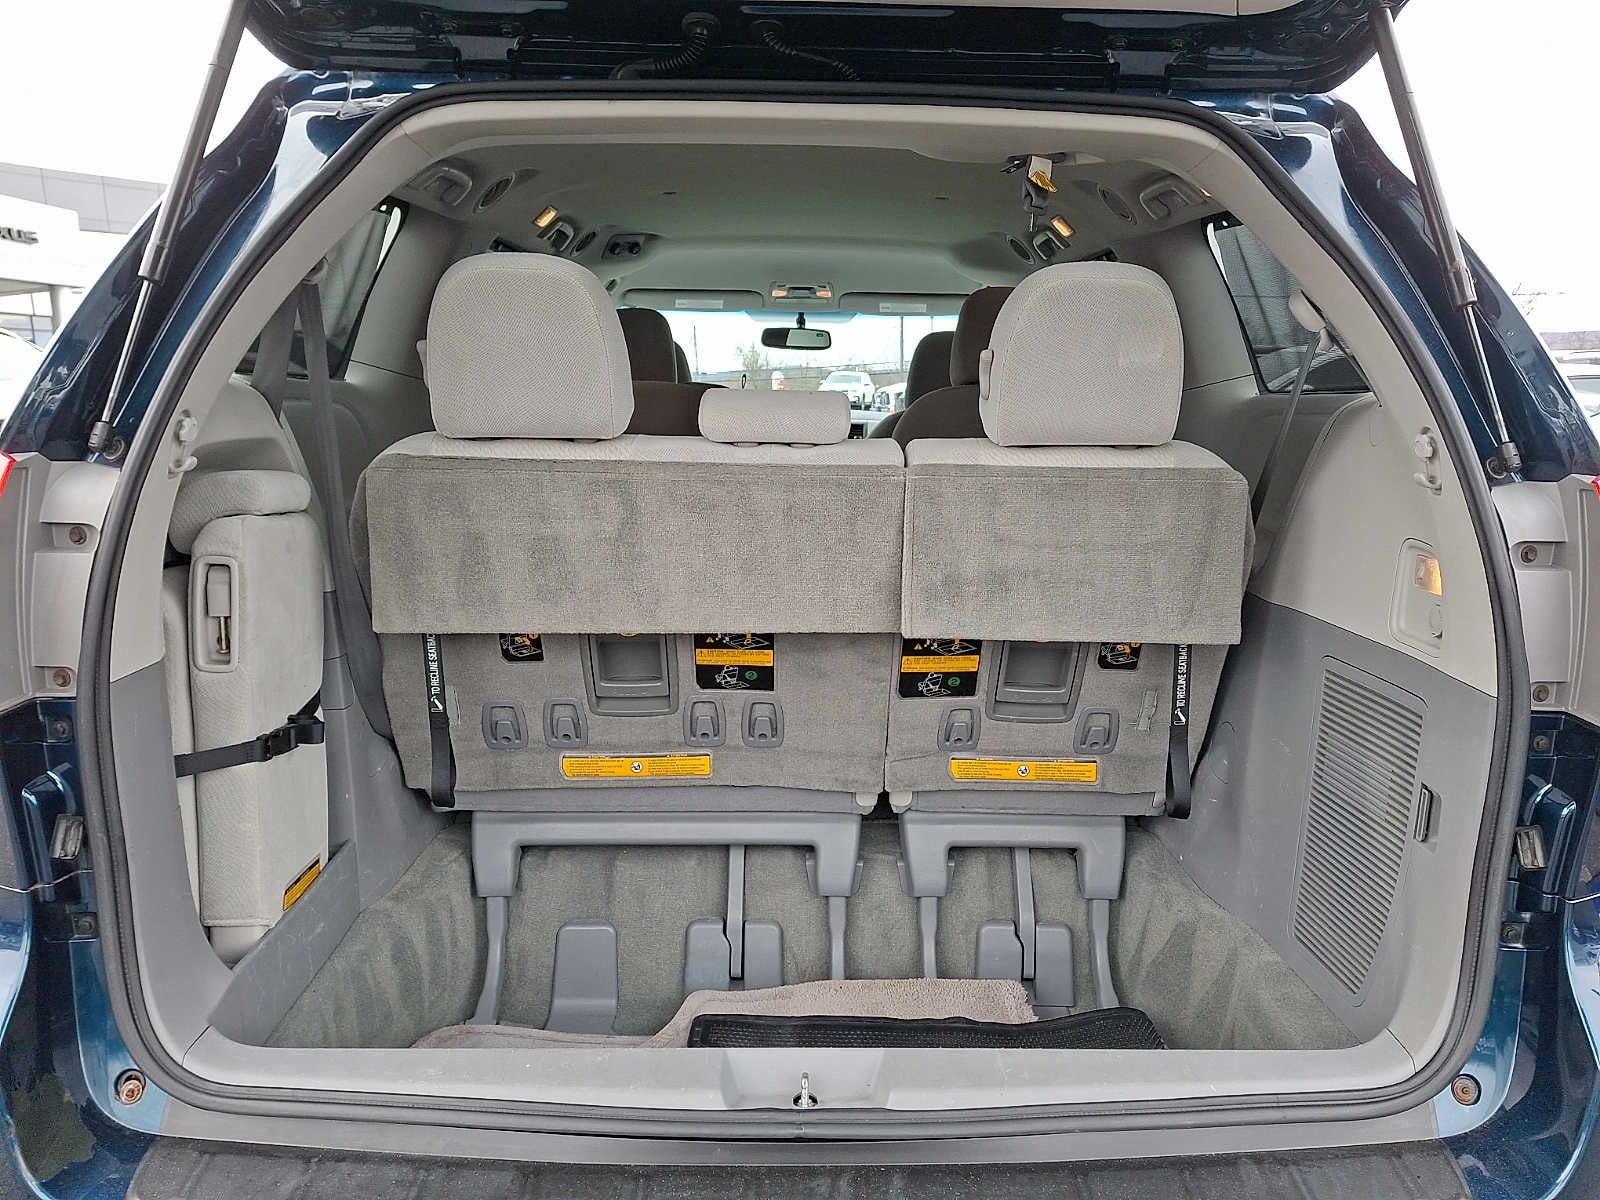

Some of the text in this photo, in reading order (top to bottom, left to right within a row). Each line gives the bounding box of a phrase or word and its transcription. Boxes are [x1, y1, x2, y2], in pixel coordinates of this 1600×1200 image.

[429, 660, 440, 687] RECLINE
[431, 686, 441, 695] TO
[1176, 674, 1187, 699] RECLINE
[1176, 699, 1186, 708] TO
